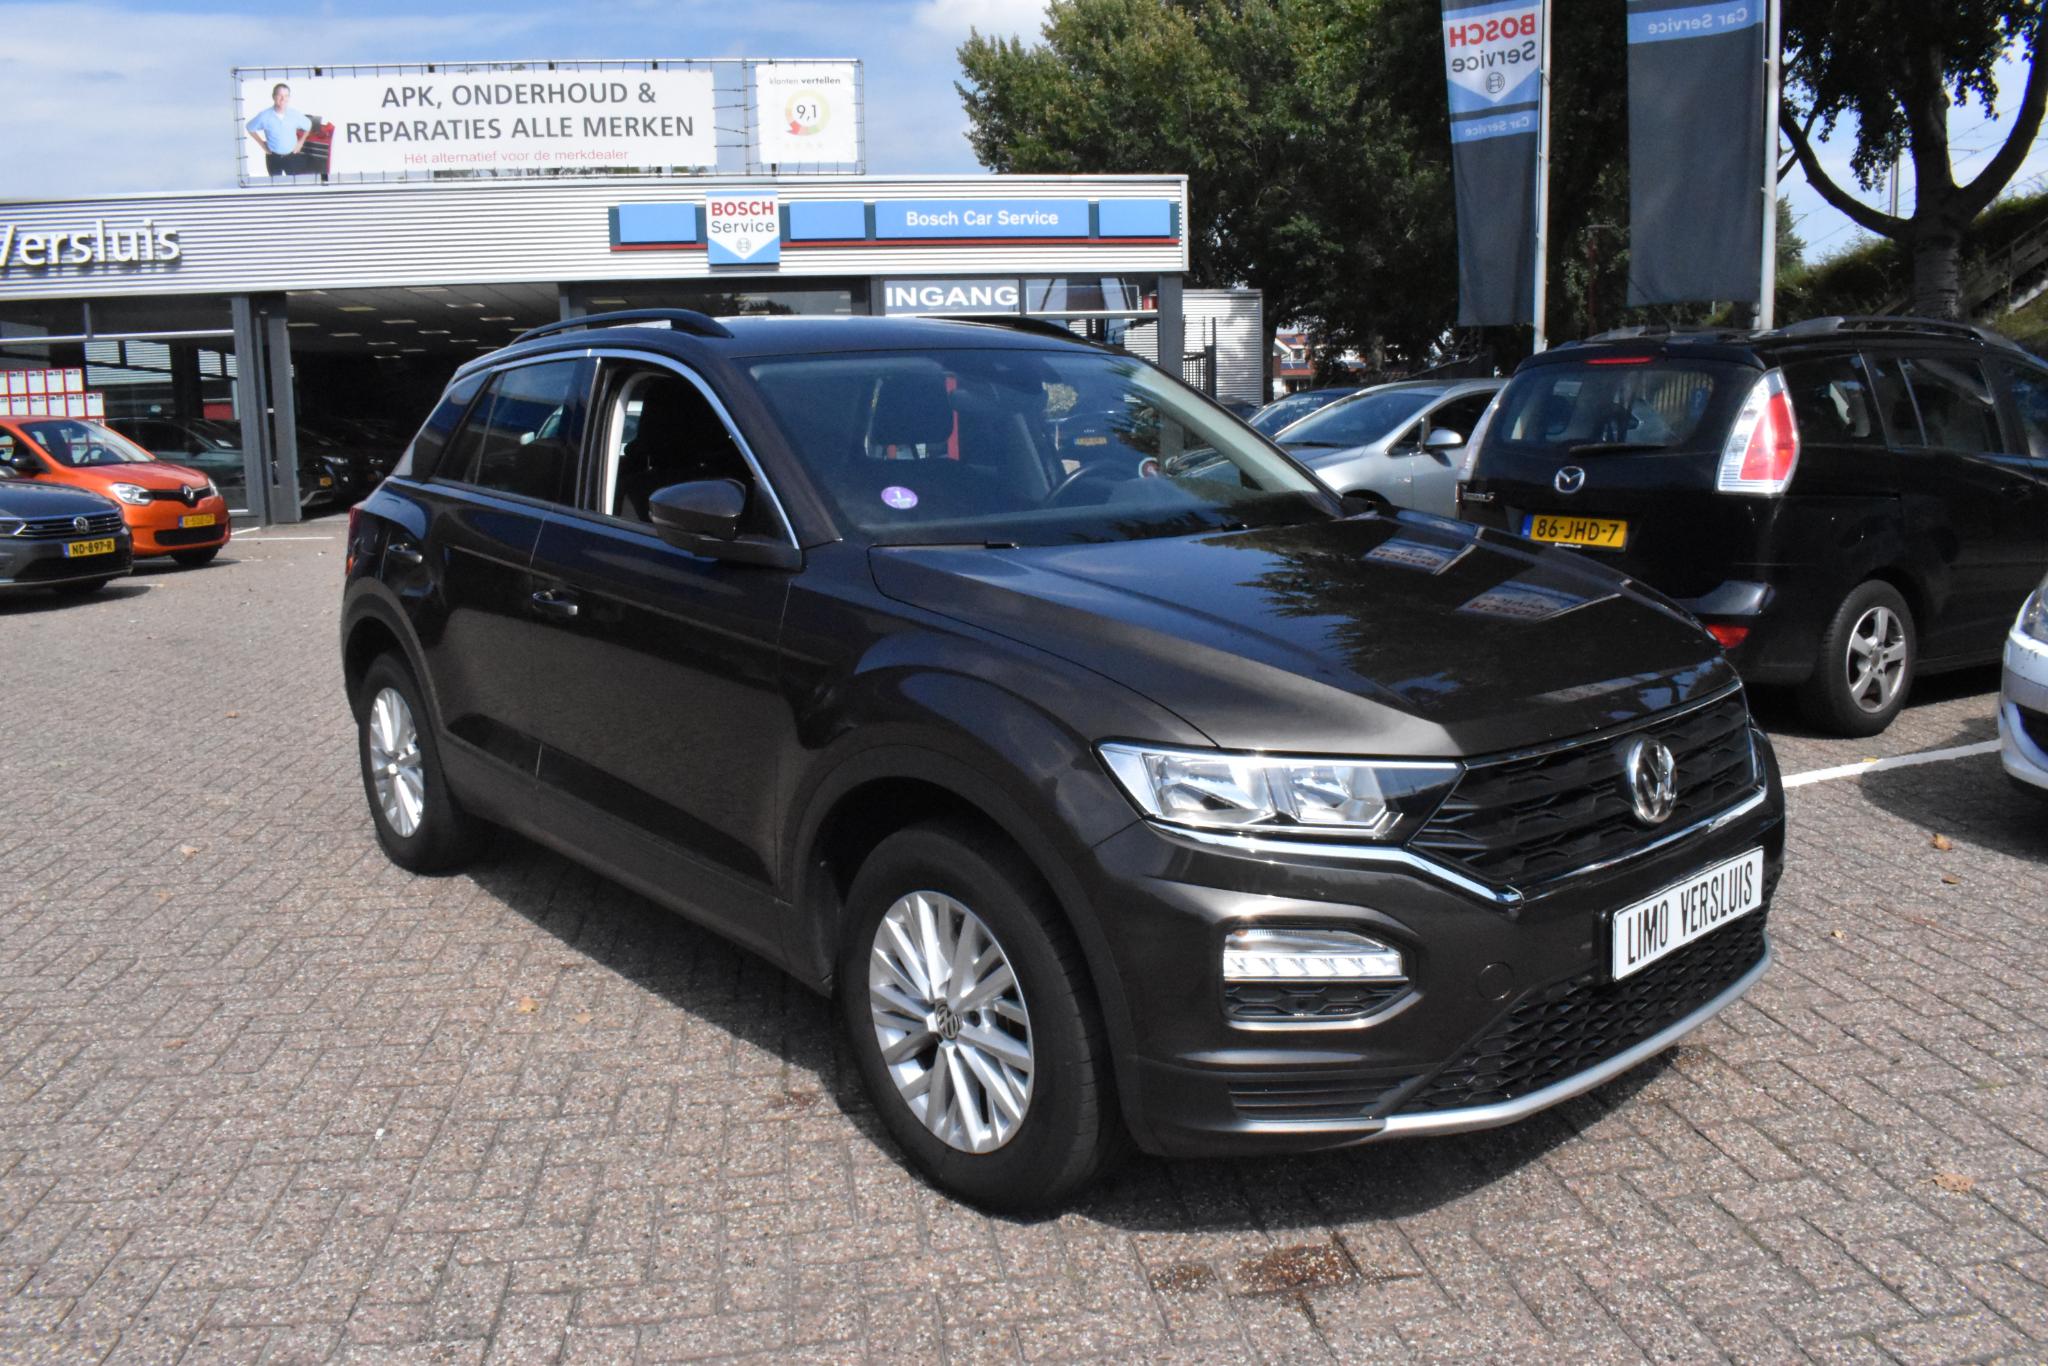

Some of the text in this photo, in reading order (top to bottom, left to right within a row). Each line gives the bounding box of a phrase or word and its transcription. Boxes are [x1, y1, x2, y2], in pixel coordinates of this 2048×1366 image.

[801, 76, 841, 85] vertellen
[381, 82, 657, 109] APK, ONDERHOUD &
[796, 104, 817, 121] 9,1
[346, 116, 694, 143] REPARATIES ALLE MERKEN
[431, 150, 497, 164] alternatief
[501, 151, 529, 161] voor
[534, 149, 550, 161] de
[555, 148, 629, 160] merkdealer
[711, 201, 775, 217] BOSCH
[711, 219, 776, 234] Service
[906, 210, 1059, 226] Bosch Car Service
[886, 286, 1019, 307] INGANG
[1536, 518, 1620, 542] 86-JHD-7
[1627, 861, 1753, 965] LIMO VERSLUIS
